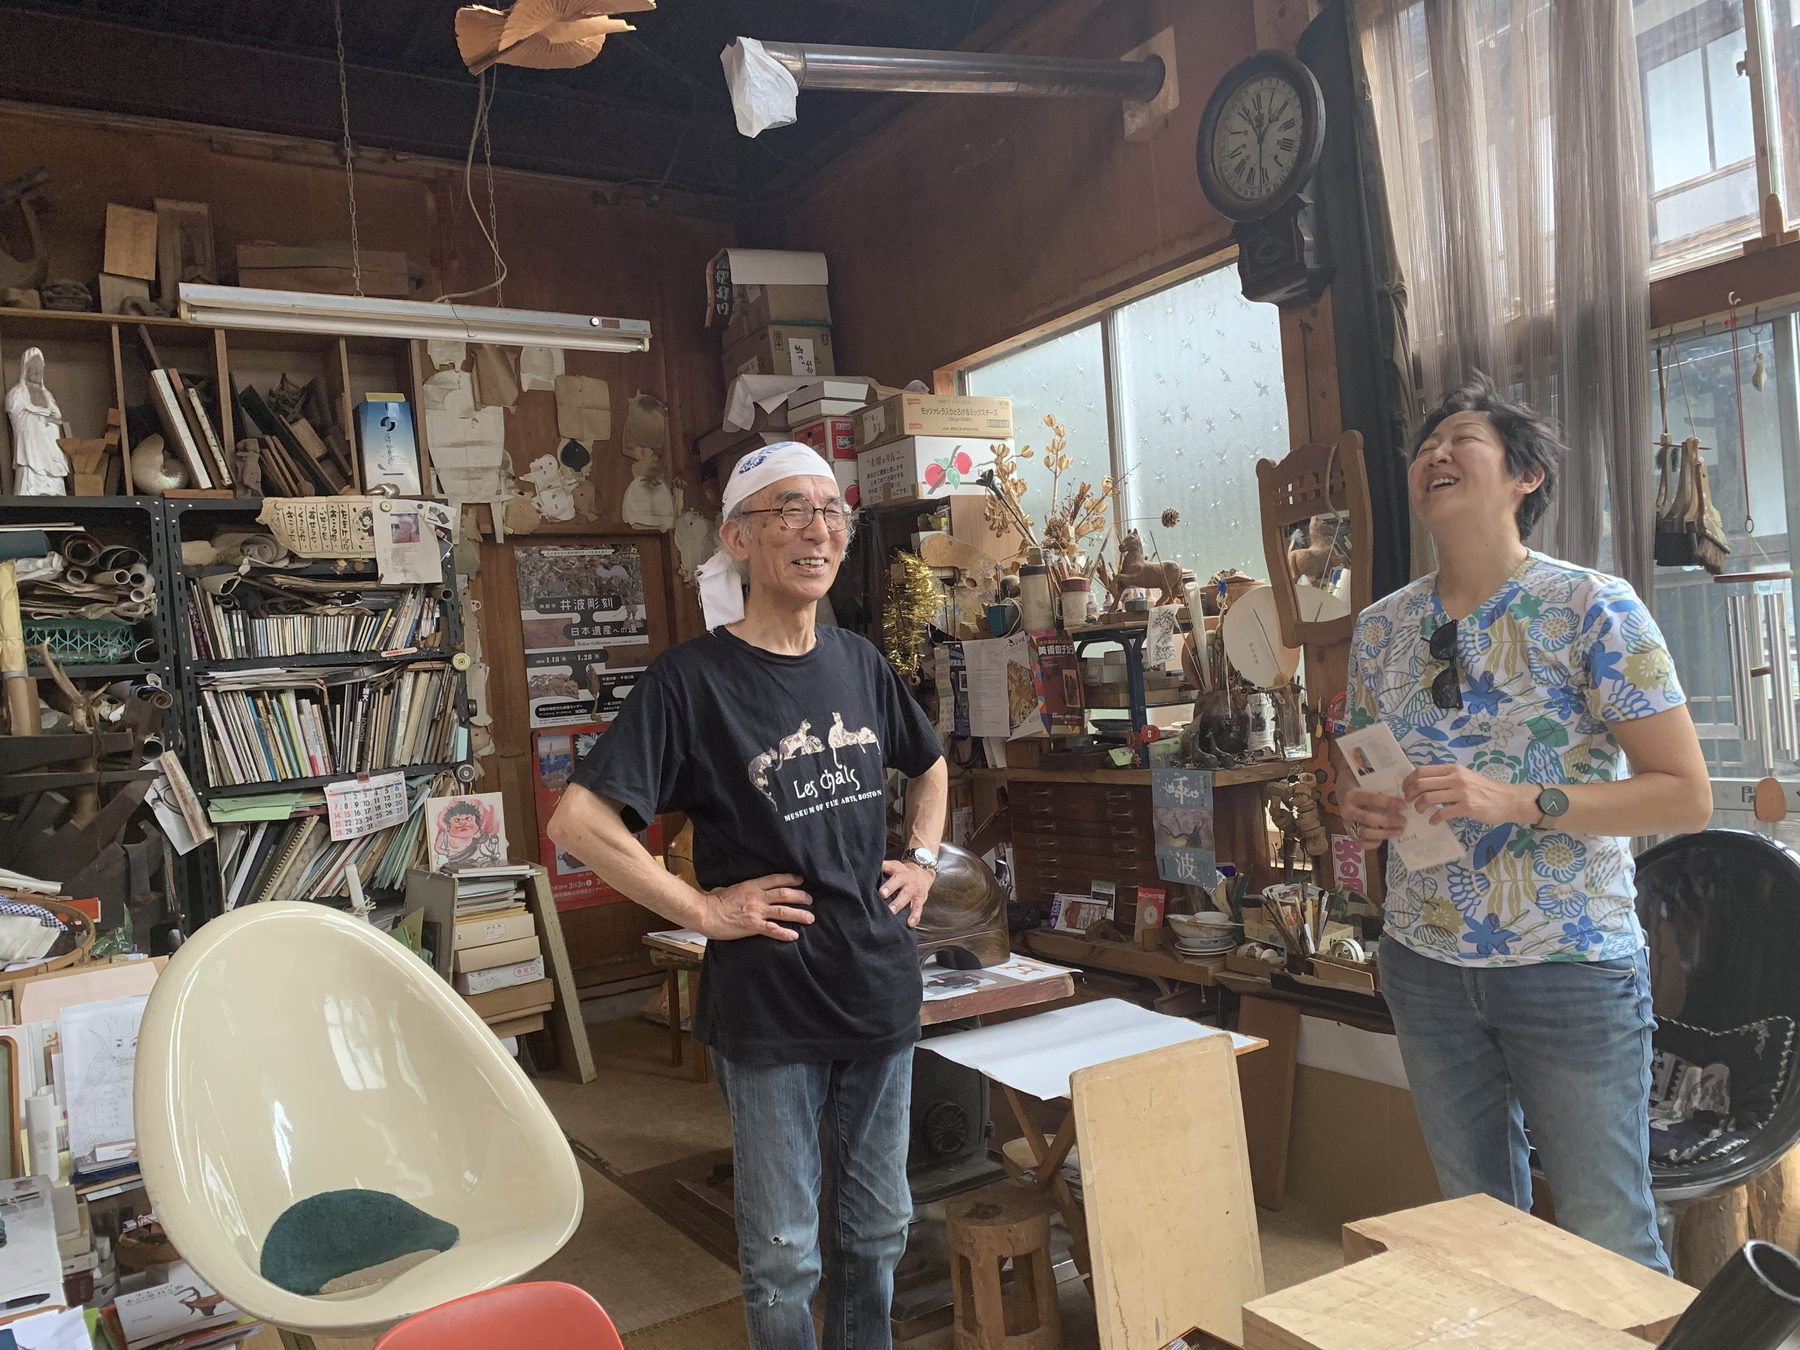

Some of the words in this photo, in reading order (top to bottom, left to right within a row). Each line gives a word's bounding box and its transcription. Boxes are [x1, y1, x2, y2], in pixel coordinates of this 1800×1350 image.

[560, 597, 614, 611] 井波彫刻
[570, 623, 638, 636] 日本遺産への道
[793, 780, 818, 798] Les
[784, 807, 816, 822] MUSEUM
[816, 804, 824, 812] OF
[858, 789, 882, 801] BOSTON
[1174, 851, 1197, 880] 波
